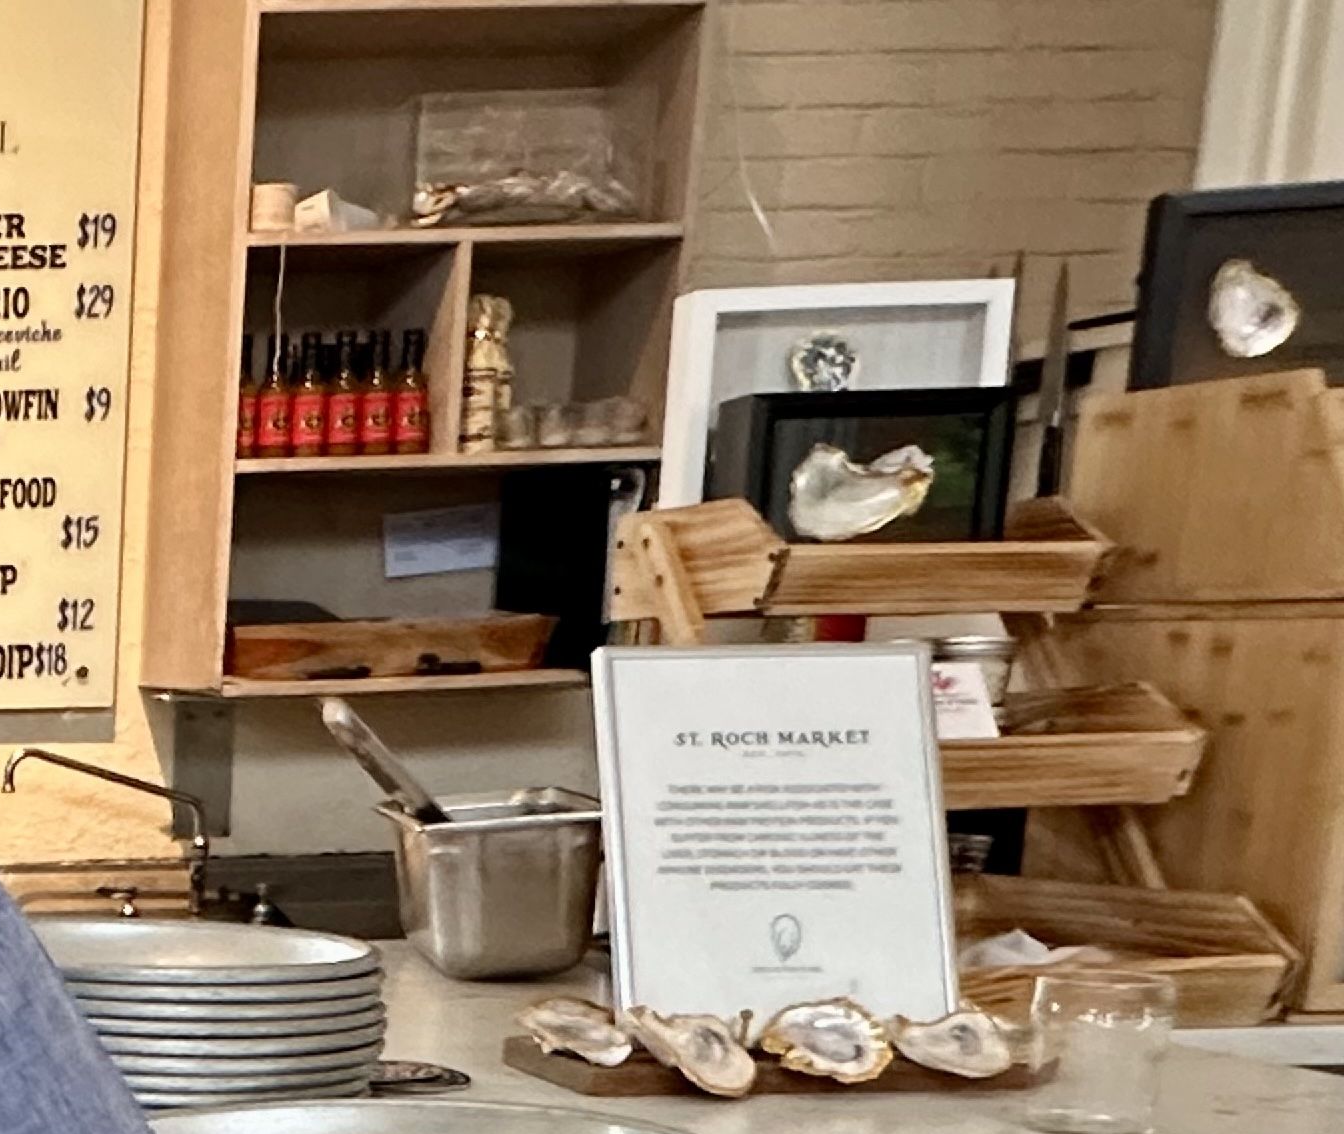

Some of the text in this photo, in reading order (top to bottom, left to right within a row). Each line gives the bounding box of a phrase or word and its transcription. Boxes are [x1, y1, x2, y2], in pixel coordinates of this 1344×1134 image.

[77, 212, 116, 250] $19
[74, 283, 114, 320] $29
[84, 386, 111, 423] $9
[61, 514, 99, 550] $15
[57, 597, 95, 632] $12
[711, 731, 769, 750] ROCH
[777, 729, 870, 748] MARKET
